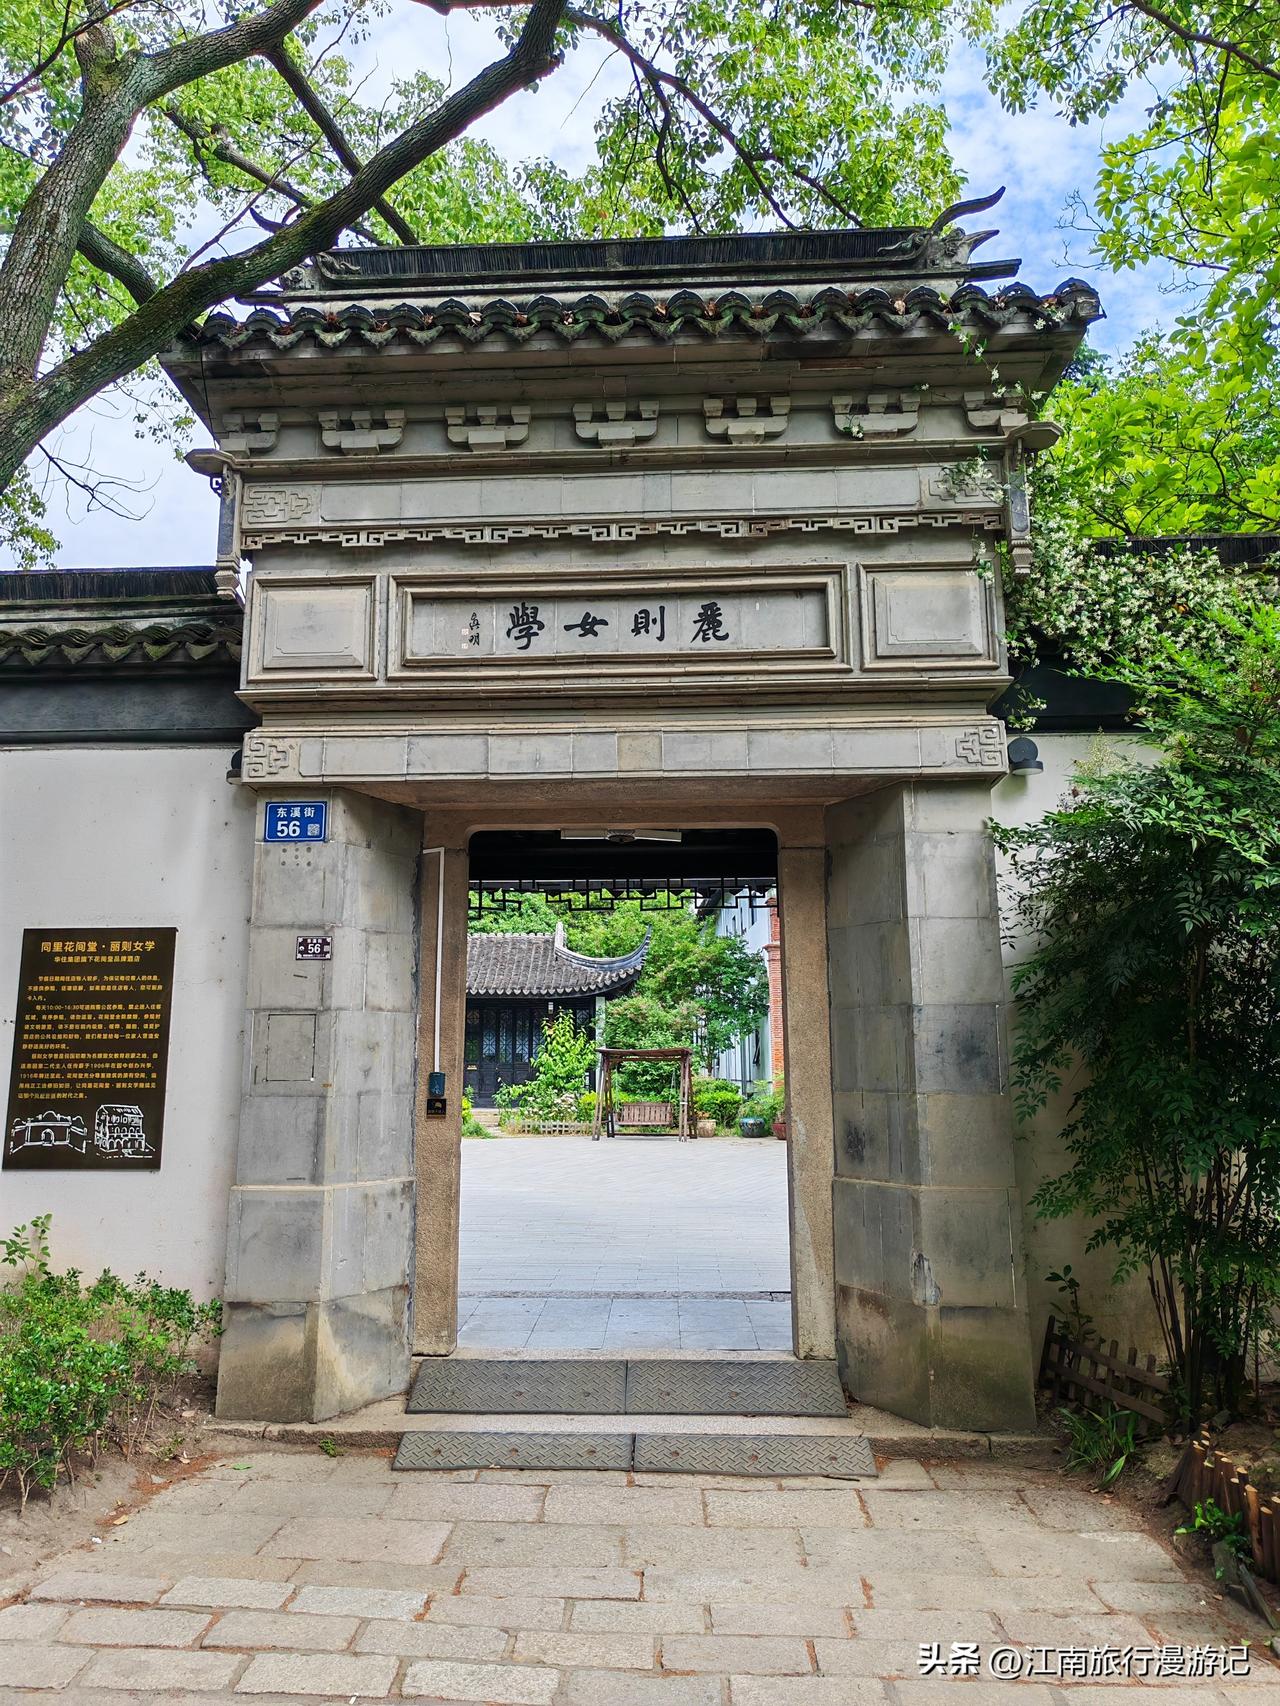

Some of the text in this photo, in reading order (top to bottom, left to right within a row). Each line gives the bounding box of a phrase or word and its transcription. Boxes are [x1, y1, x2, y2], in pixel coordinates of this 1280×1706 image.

[276, 807, 315, 818] 东溪街
[276, 821, 301, 837] 56
[308, 943, 321, 954] 56
